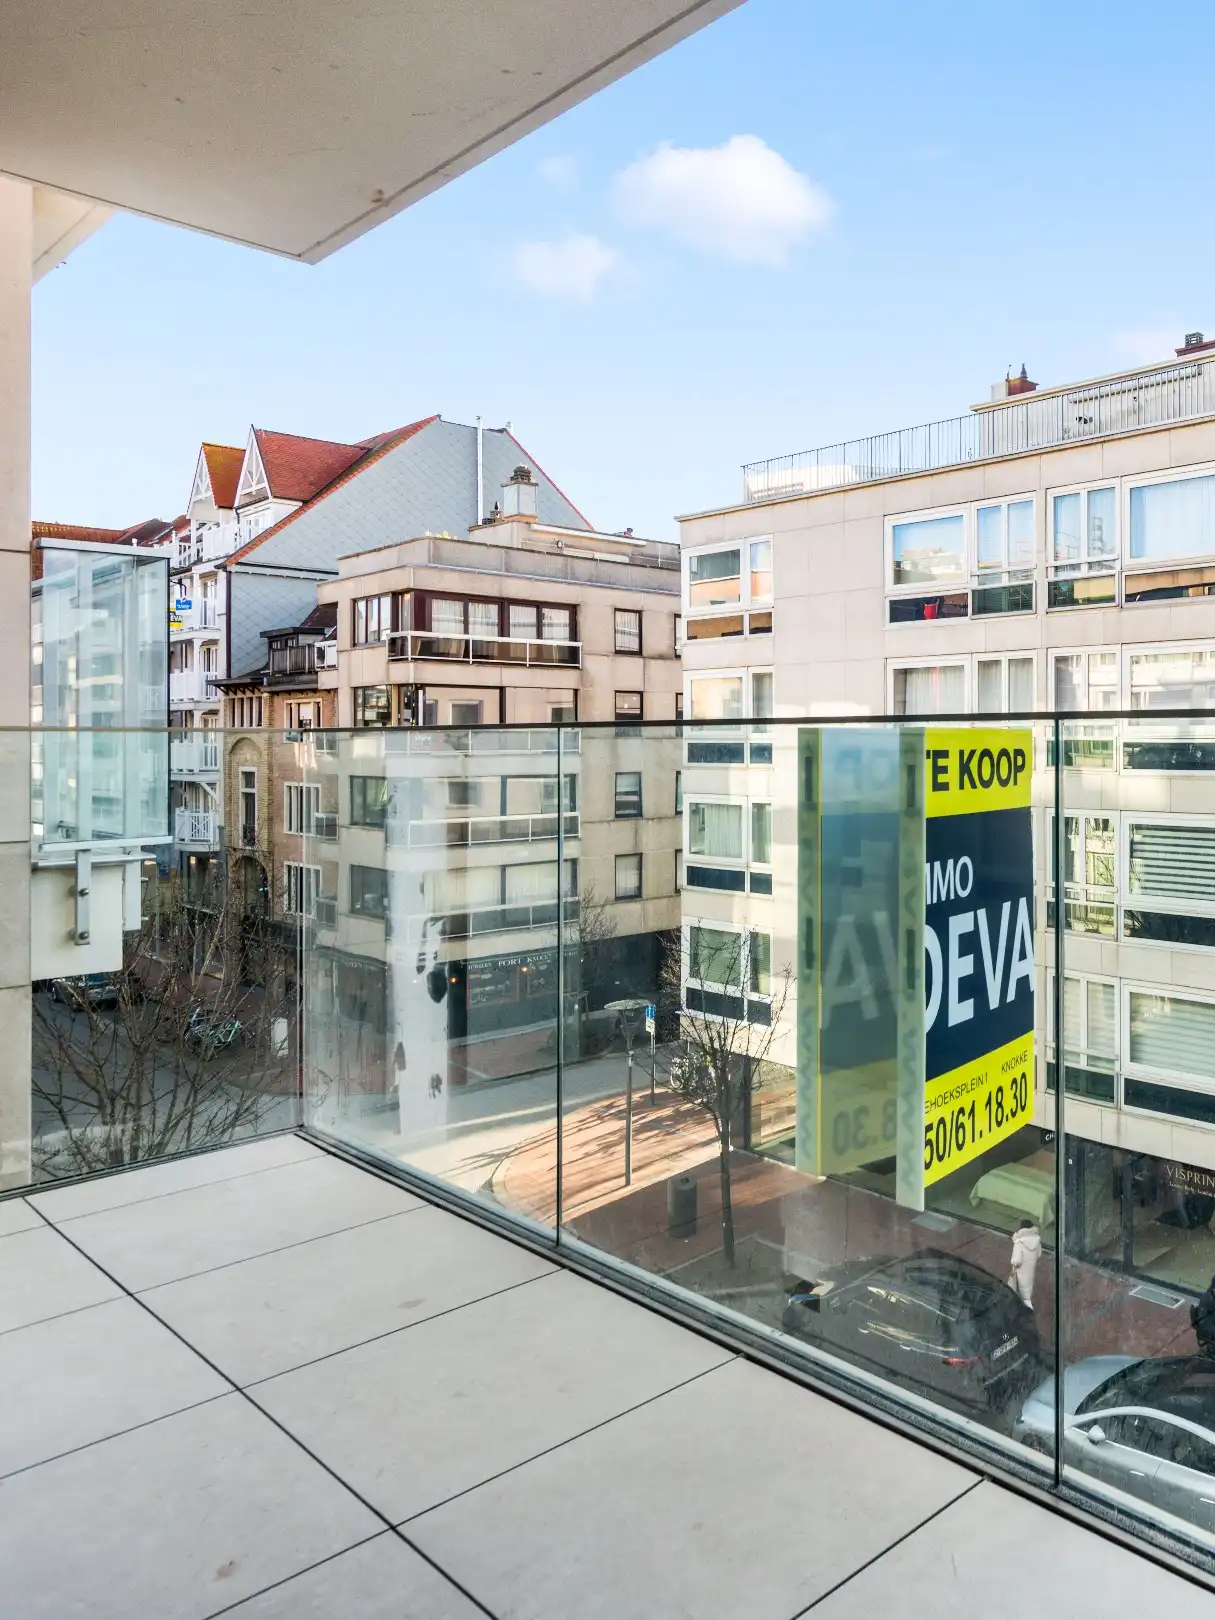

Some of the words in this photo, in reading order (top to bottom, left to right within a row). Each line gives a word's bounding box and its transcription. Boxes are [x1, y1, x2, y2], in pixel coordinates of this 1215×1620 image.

[926, 750, 950, 792] E
[958, 748, 1026, 791] KOOP
[925, 1076, 984, 1115] EHOEKSPLEIN
[1001, 1049, 1028, 1074] KNOKKE
[924, 1071, 1028, 1171] 50/61.18.30
